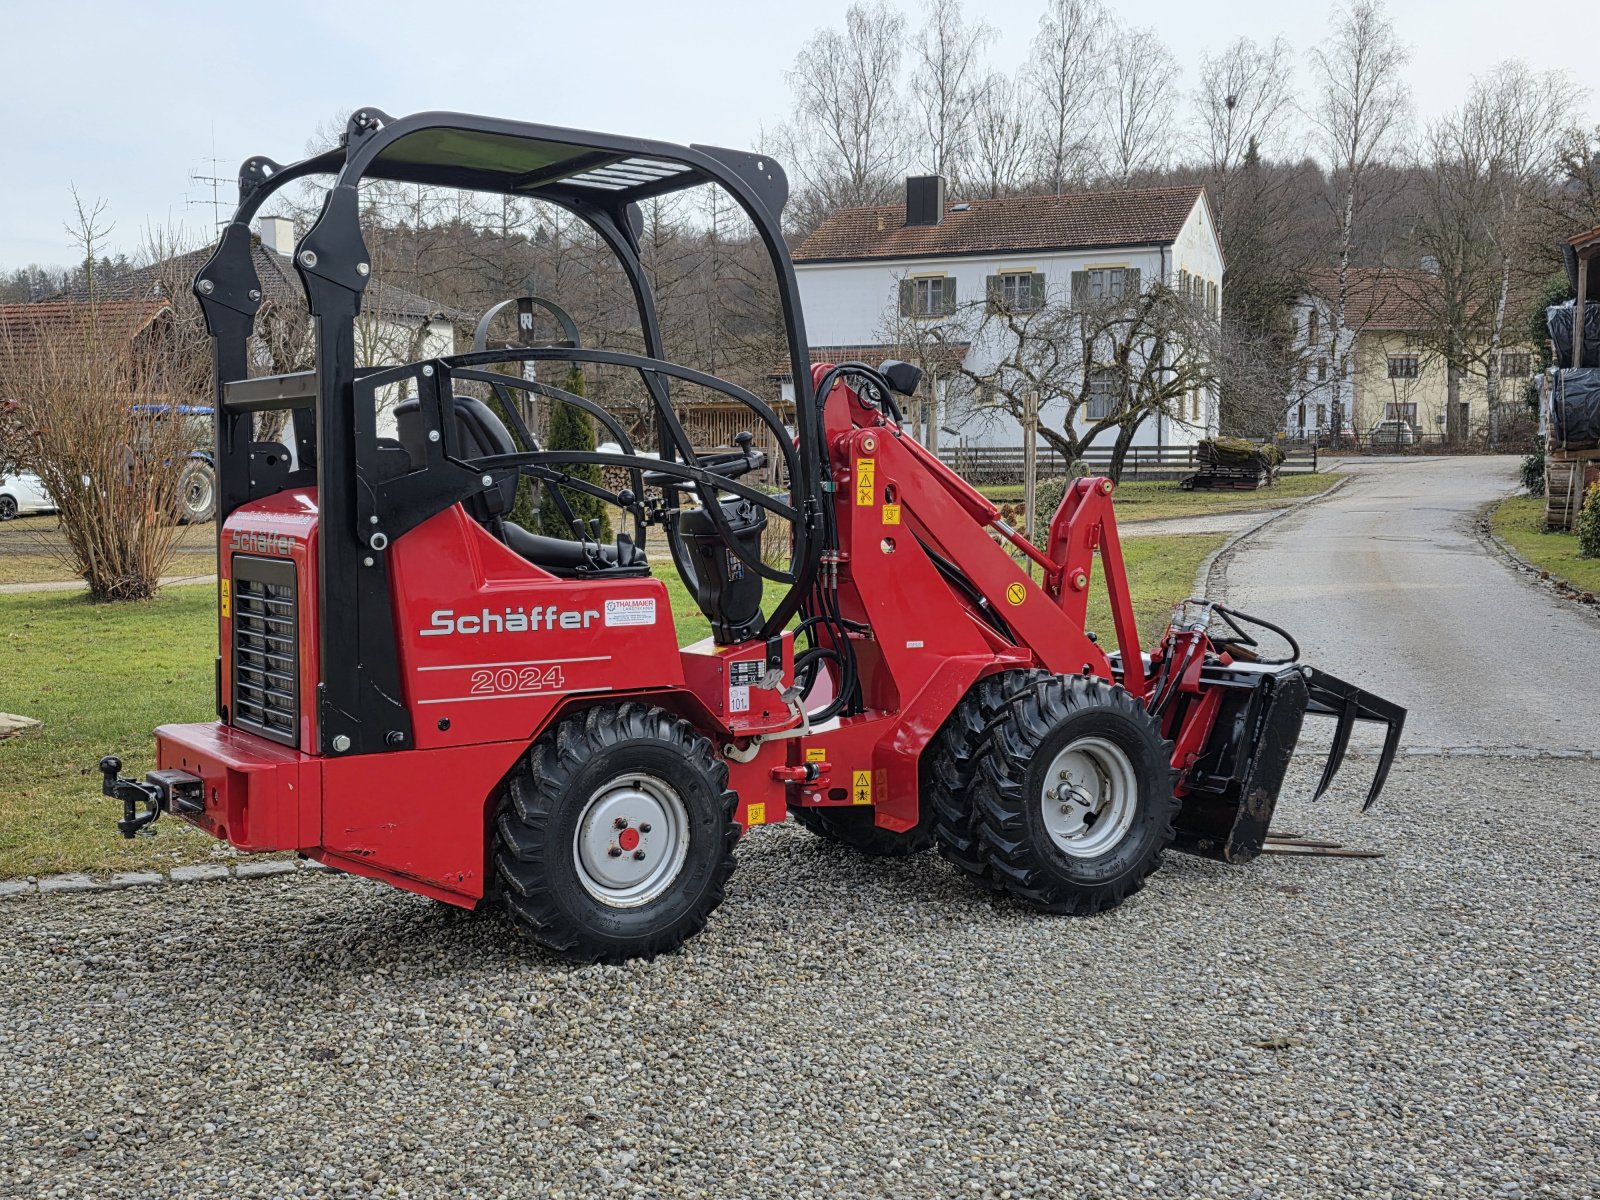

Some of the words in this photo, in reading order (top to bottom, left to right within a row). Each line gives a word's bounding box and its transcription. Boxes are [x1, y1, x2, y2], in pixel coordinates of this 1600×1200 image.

[229, 527, 296, 556] Schäffer
[419, 606, 600, 636] Schäffer
[471, 666, 564, 694] 2024
[731, 697, 744, 711] 101
